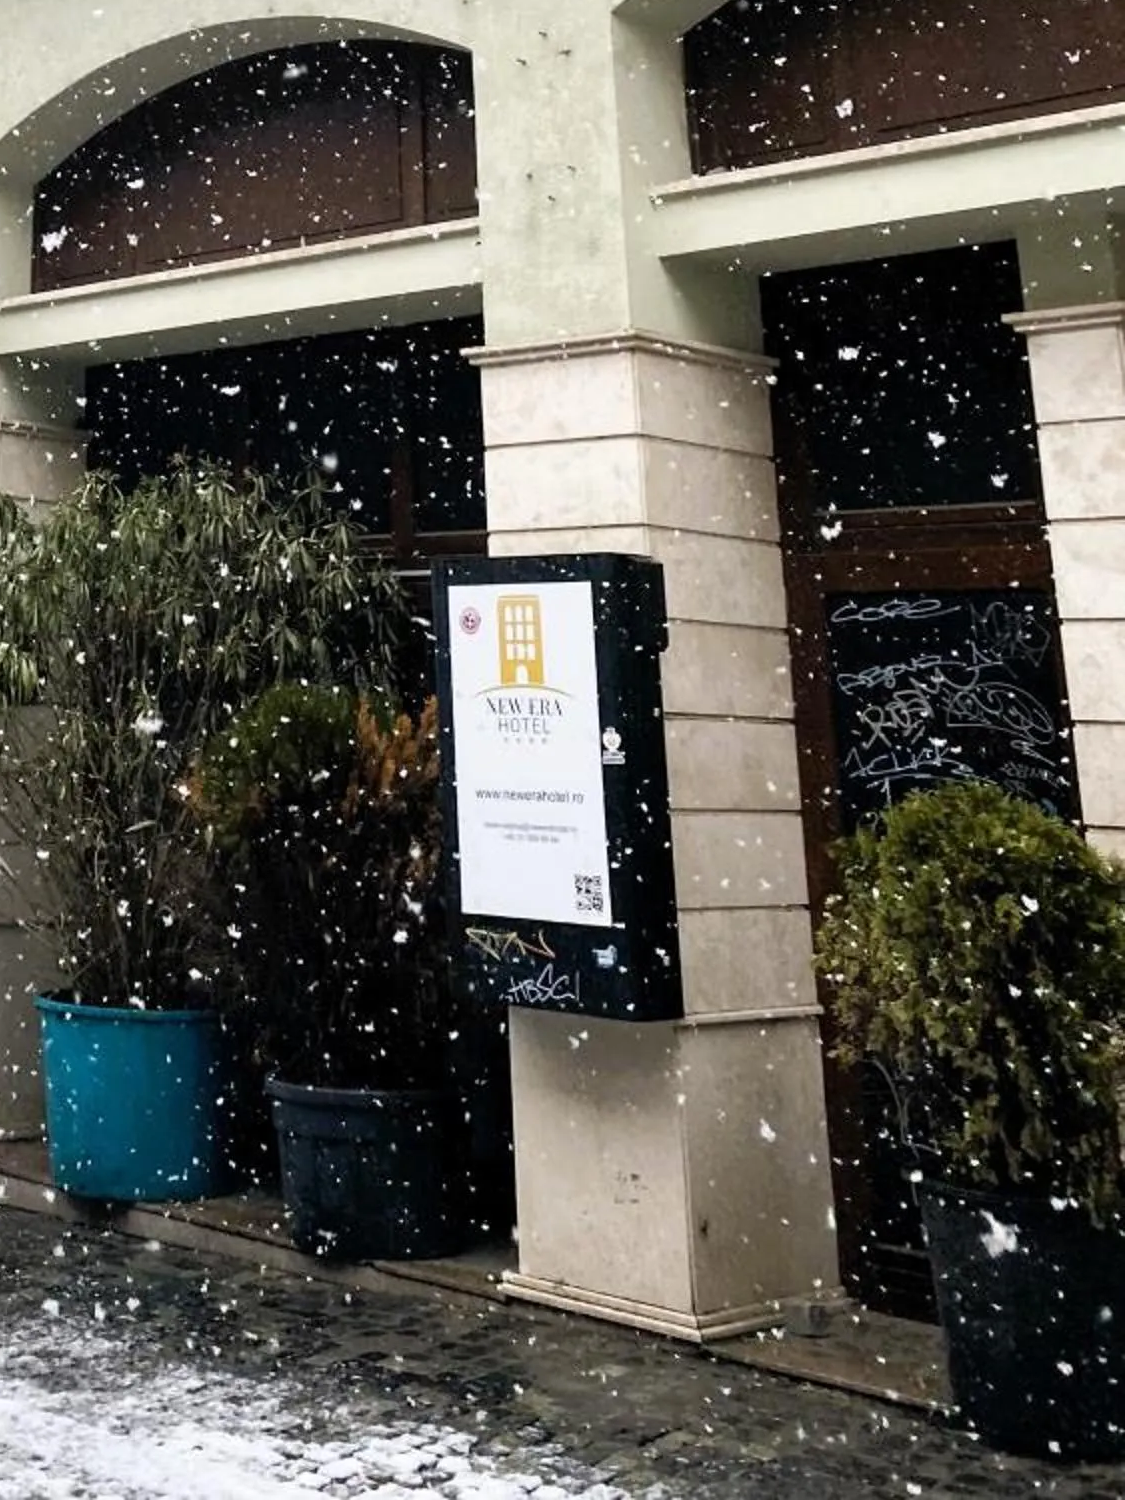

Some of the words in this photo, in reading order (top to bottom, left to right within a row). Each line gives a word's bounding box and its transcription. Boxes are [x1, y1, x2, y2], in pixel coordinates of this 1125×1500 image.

[485, 697, 523, 715] NEW
[528, 698, 564, 717] ERA
[497, 716, 551, 735] HOTEL
